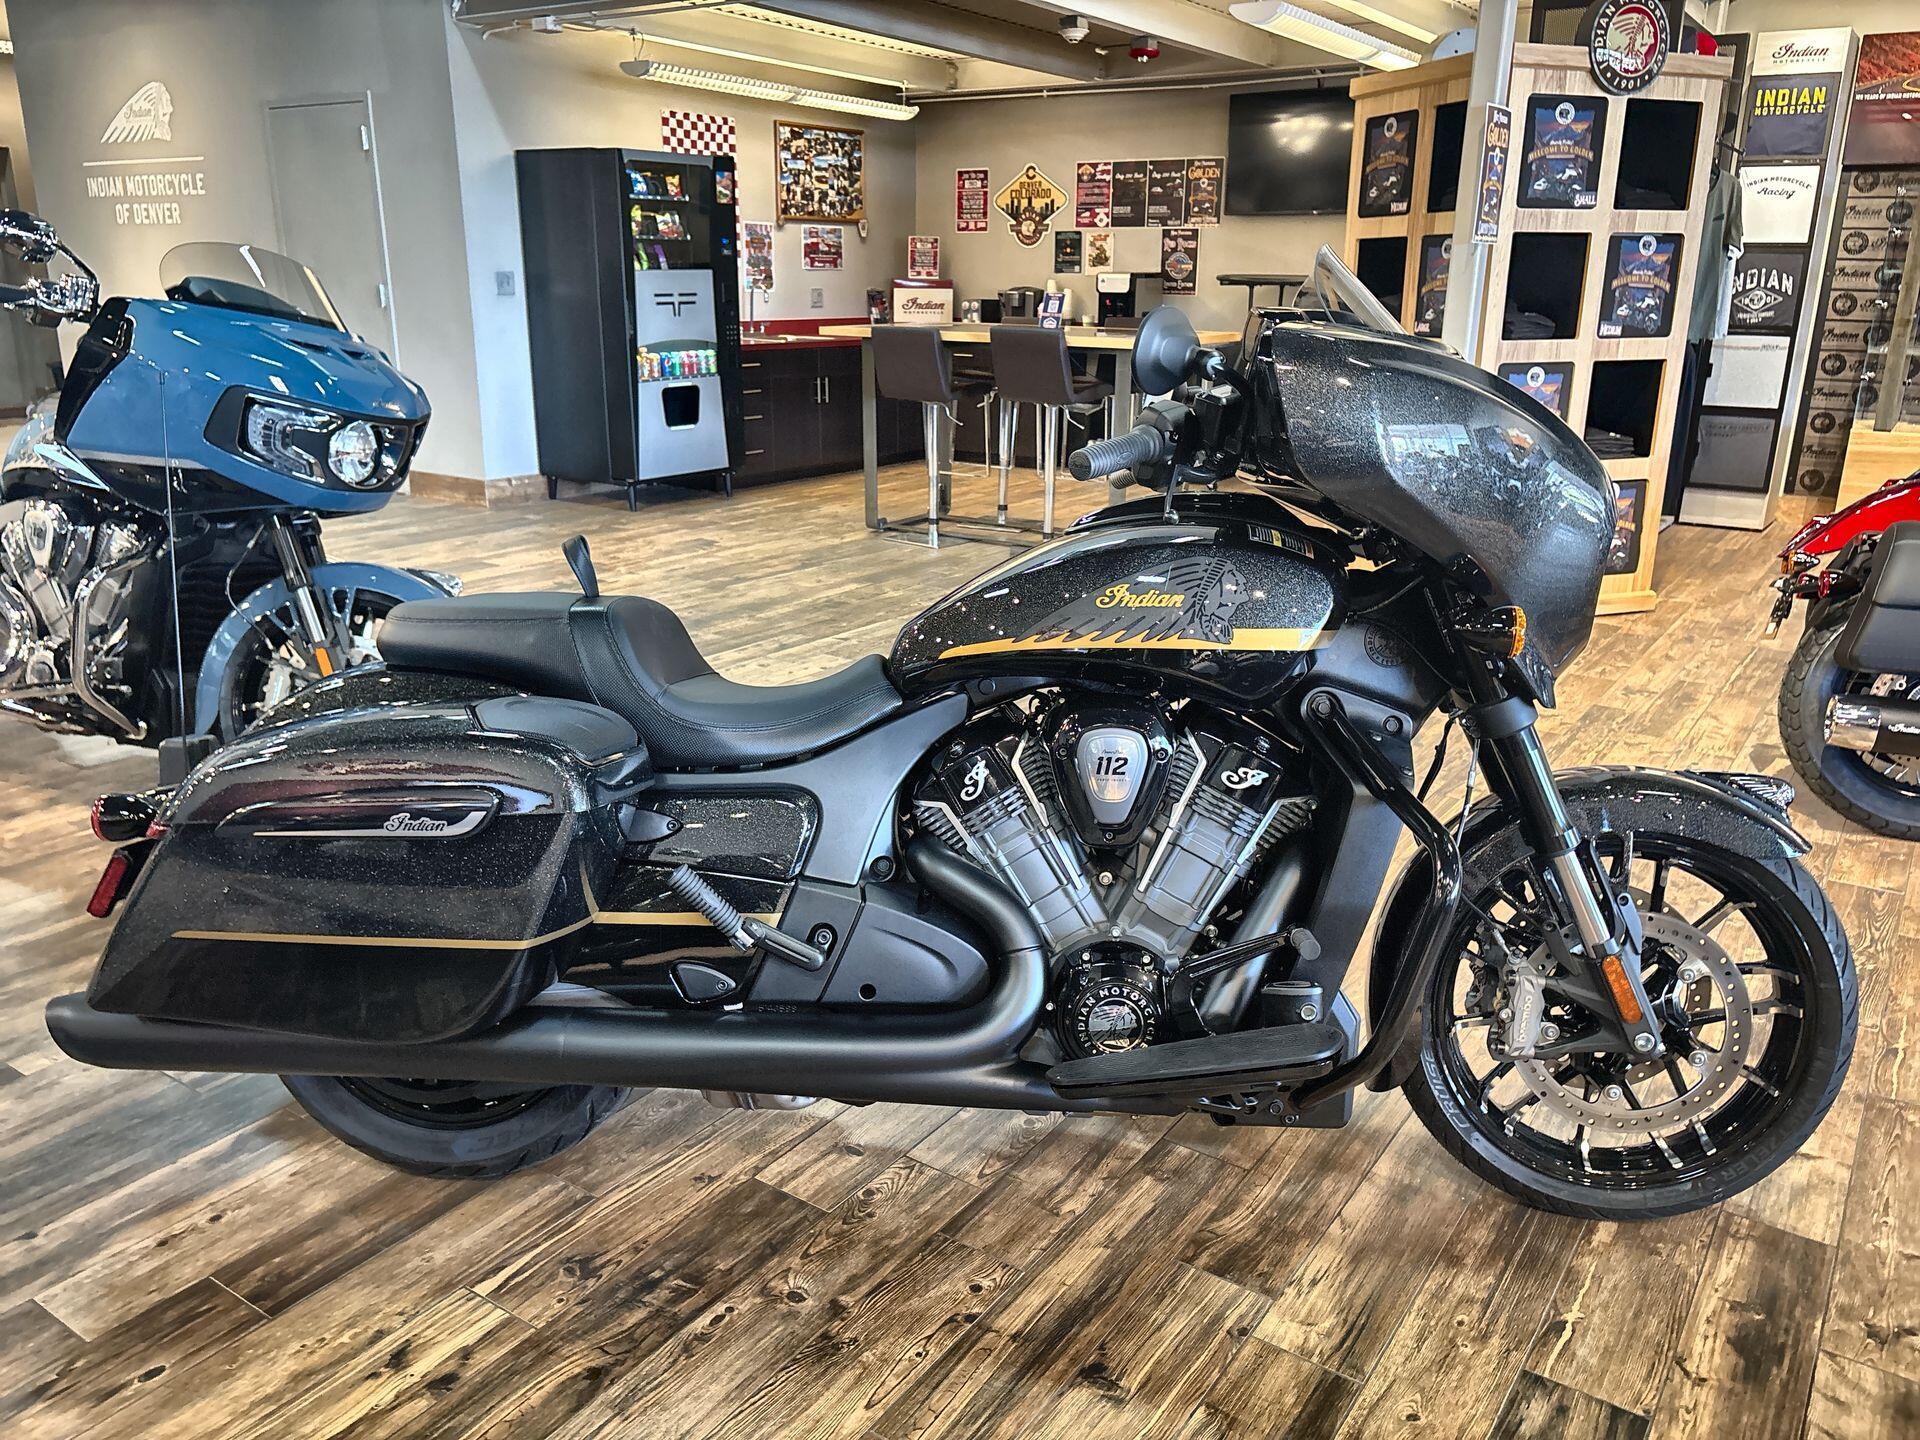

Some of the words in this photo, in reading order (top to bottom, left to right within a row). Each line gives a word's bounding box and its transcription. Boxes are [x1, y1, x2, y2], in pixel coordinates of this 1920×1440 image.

[1594, 5, 1614, 69] IDIAN
[1772, 42, 1829, 59] Indian
[1613, 77, 1640, 89] 1901
[1755, 86, 1827, 107] INDIAN
[1754, 104, 1826, 116] MOTORCYCLE
[1487, 122, 1509, 148] GOLDEN
[1528, 145, 1558, 161] WELCOME
[1560, 145, 1569, 153] TO
[1570, 145, 1594, 161] GOLDEN
[1188, 167, 1220, 180] GOLDEN
[86, 176, 125, 198] INDIAN
[125, 173, 206, 197] MOTORCYCLE
[1019, 181, 1043, 190] DENVER
[1747, 178, 1769, 188] INDIAN
[1770, 176, 1811, 189] MOTORCYCLE
[1010, 188, 1052, 200] COLORADO
[1574, 193, 1597, 207] SMALL
[1757, 187, 1796, 199] Racing
[115, 203, 131, 225] OF
[133, 202, 181, 225] DENVER
[1845, 205, 1883, 217] Indian
[1835, 264, 1872, 278] Indian
[1611, 275, 1639, 290] WELCOME
[1641, 275, 1649, 283] TO
[1732, 268, 1794, 296] NDIAN
[901, 297, 945, 310] Indian
[1823, 328, 1860, 341] Indian
[1812, 388, 1849, 398] Indian
[1095, 584, 1185, 608] Indian
[1096, 757, 1128, 775] 112
[385, 813, 447, 832] Indian
[1077, 996, 1096, 1048] INDIAN
[1099, 987, 1155, 1049] MOTORCYCLE
